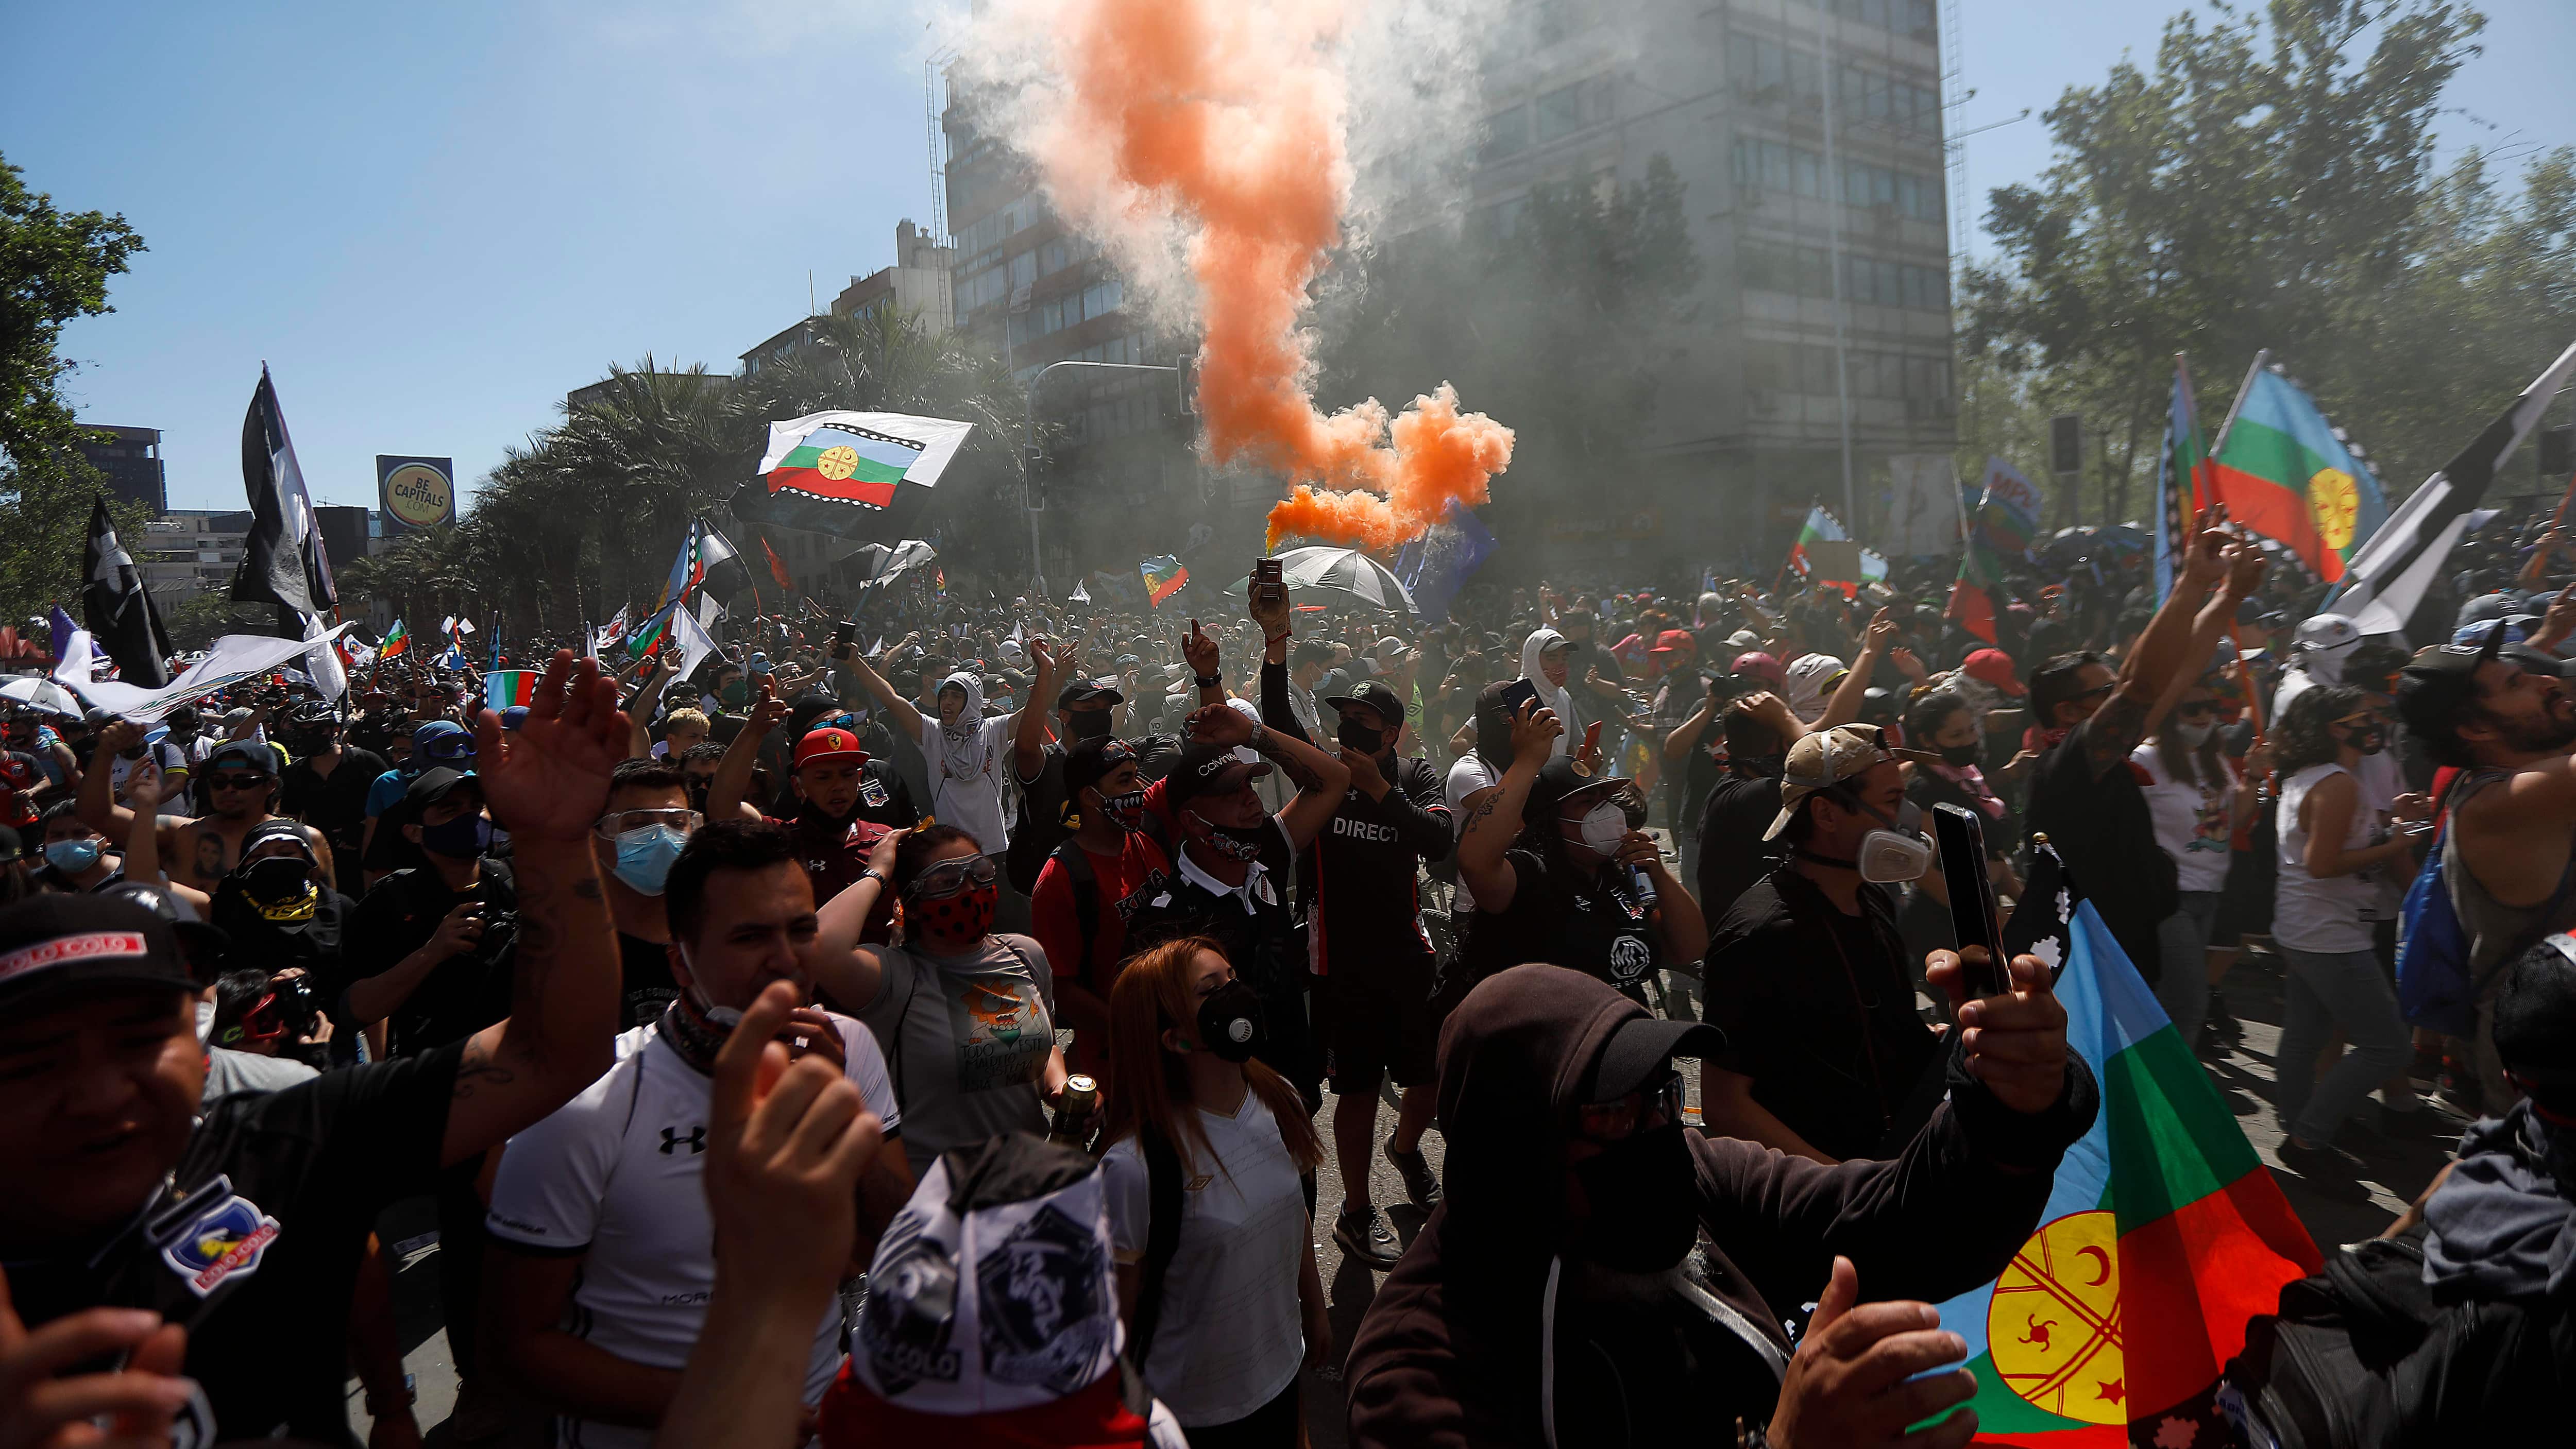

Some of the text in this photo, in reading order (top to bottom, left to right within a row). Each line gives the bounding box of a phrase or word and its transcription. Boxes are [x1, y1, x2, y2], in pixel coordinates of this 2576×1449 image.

[416, 477, 430, 491] BE
[395, 484, 444, 507] CAPITALS
[405, 500, 429, 513] .COM
[66, 936, 127, 956] COLO
[960, 1038, 1043, 1059] TODO ESTE
